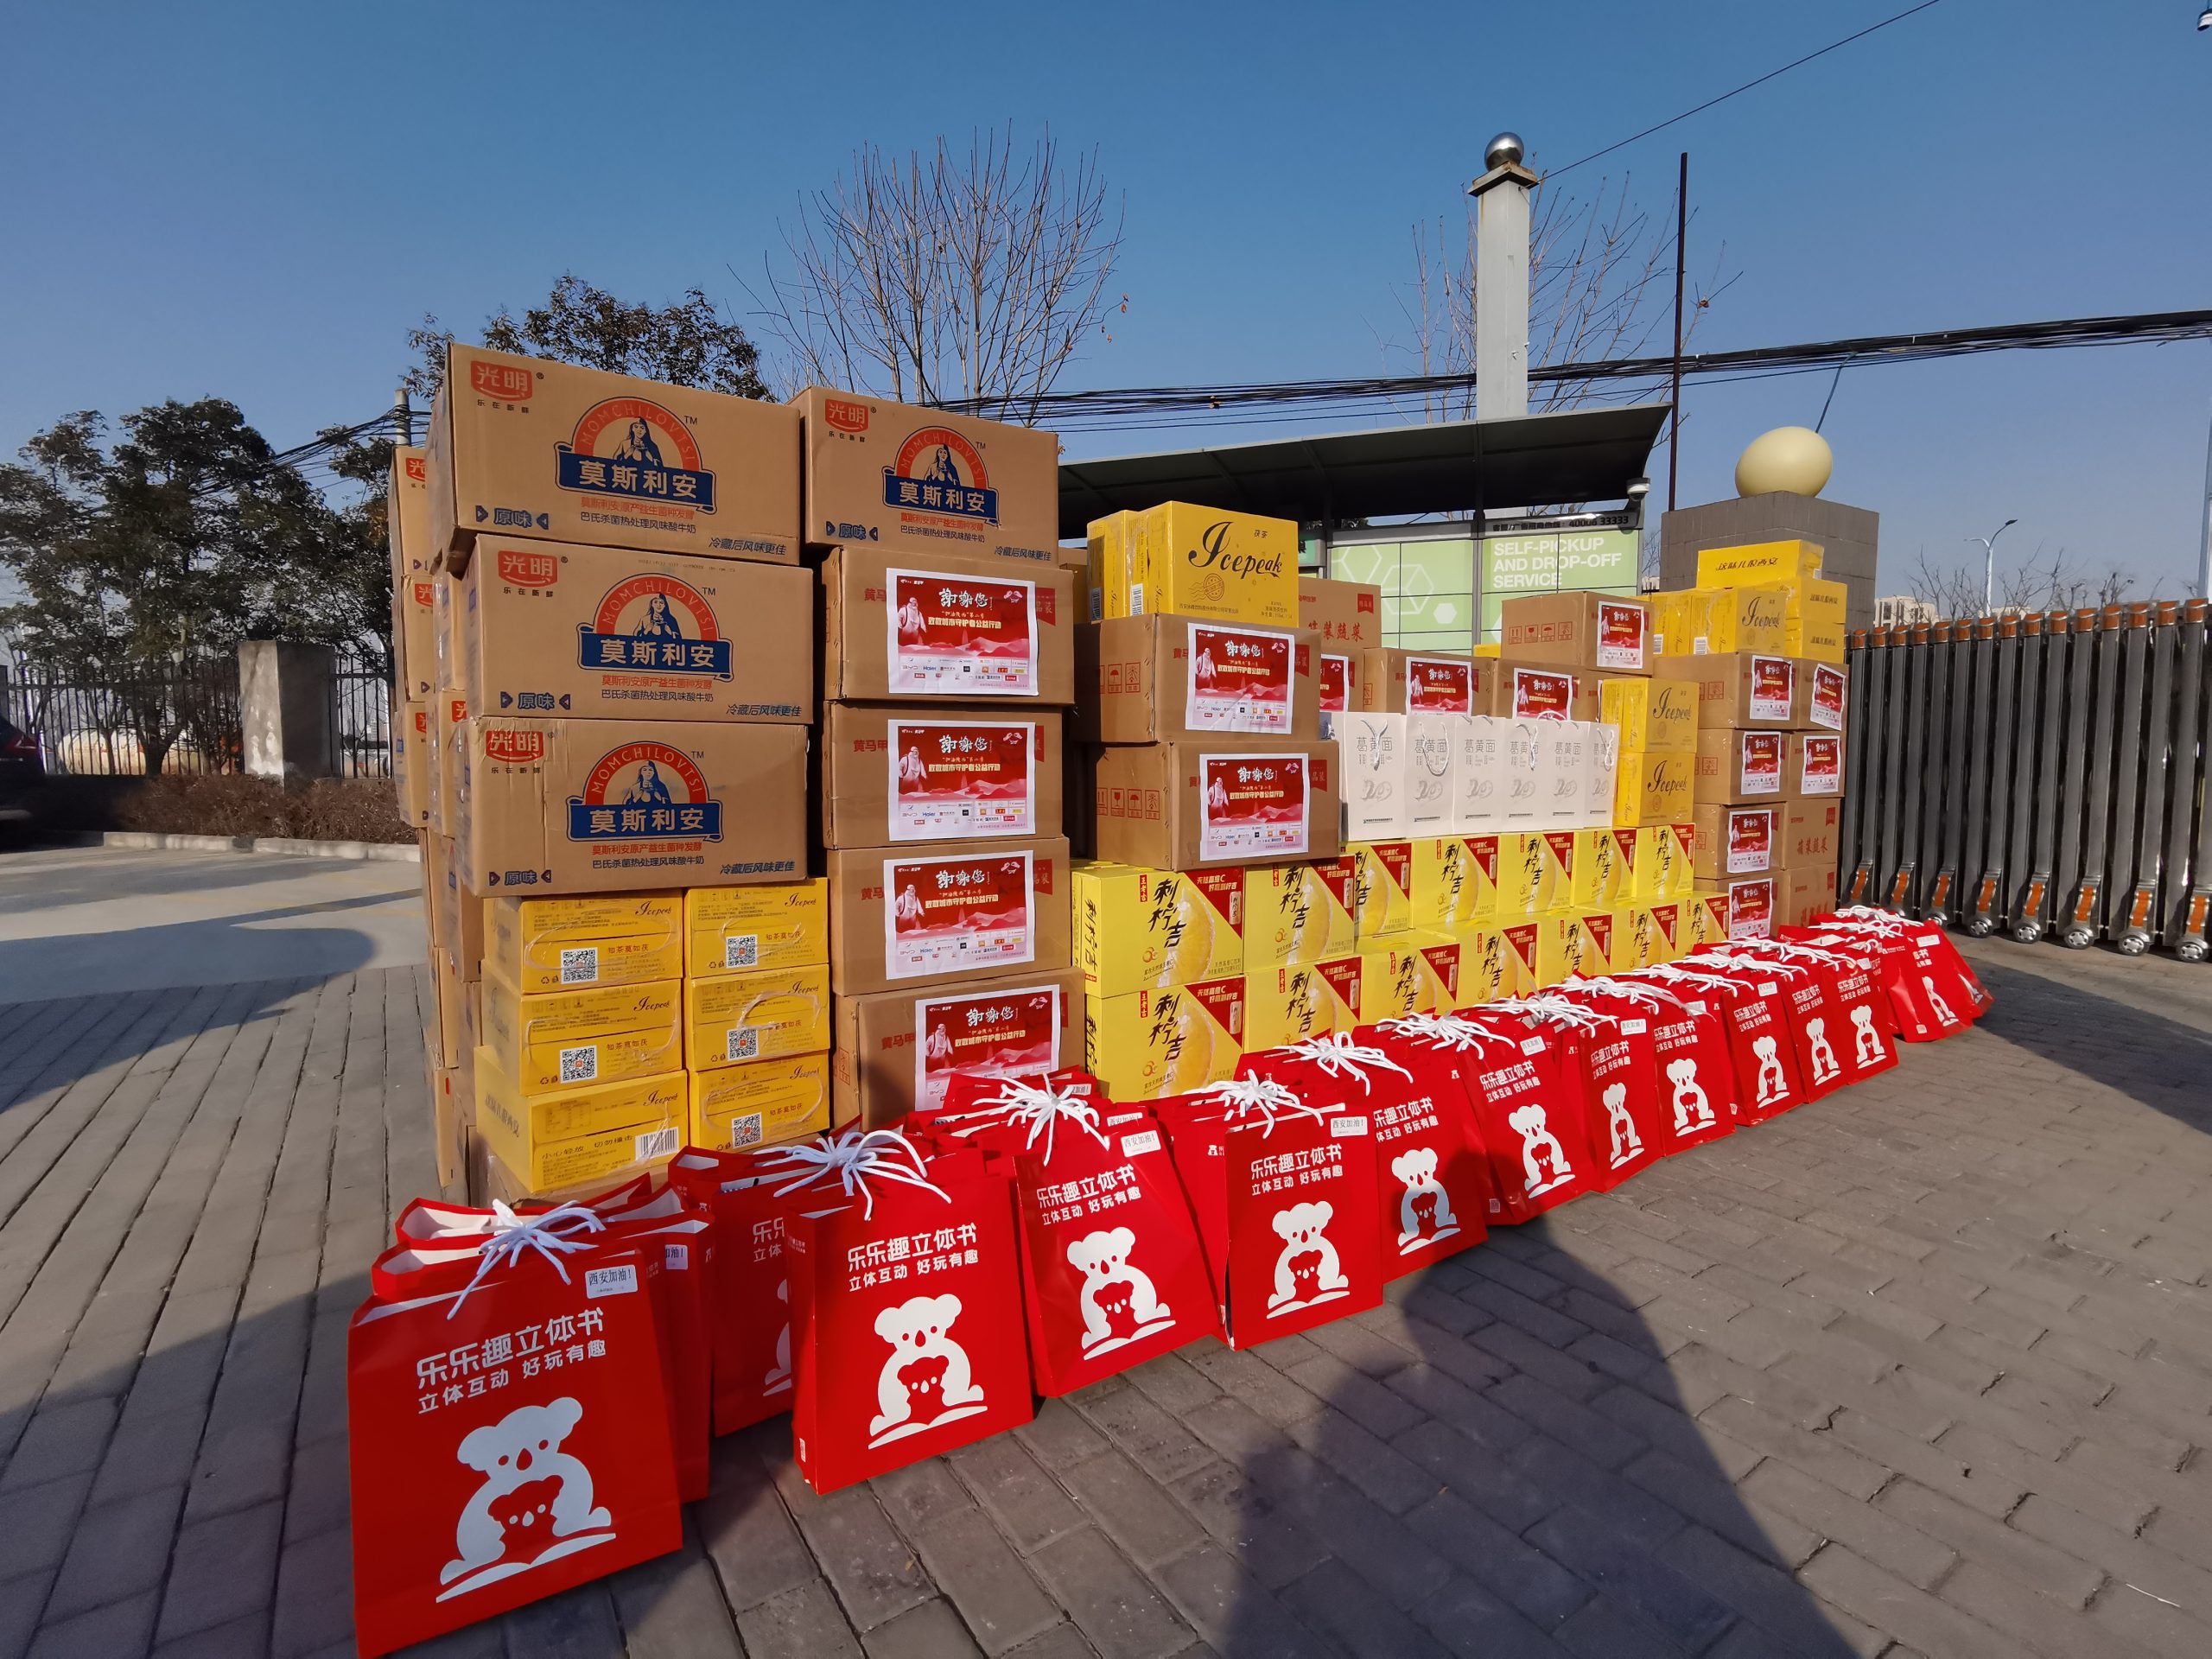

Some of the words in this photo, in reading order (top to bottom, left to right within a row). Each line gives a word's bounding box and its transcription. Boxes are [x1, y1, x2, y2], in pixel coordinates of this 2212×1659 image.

[475, 365, 528, 394] 光明
[830, 402, 865, 426] 光明
[581, 403, 696, 463] MOMCHILOVTSI
[579, 460, 698, 499] 莫斯利安
[899, 481, 985, 513] 莫斯利安
[494, 508, 531, 528] 原味
[581, 512, 696, 534] 巴氏杀菌热处理风味酸牛奶
[839, 524, 866, 540] 原味
[900, 525, 985, 543] 巴氏杀菌热处理风味酸牛奶
[709, 537, 786, 556] 冷藏后风味更佳
[995, 545, 1052, 561] 冷藏后风味更佳
[1188, 521, 1282, 580] Icepeak
[1494, 537, 1604, 556] SELF-PICKUP
[502, 556, 554, 580] 光明
[1494, 559, 1528, 572] AND
[1532, 553, 1622, 569] DROP-OFF
[1493, 573, 1562, 588] SERVICE
[602, 582, 714, 632] MOMCHILOVTSI
[600, 639, 715, 668] 莫斯利安
[518, 692, 555, 709] 原味
[601, 690, 713, 702] 巴氏杀菌热处理风味酸牛奶
[726, 703, 802, 717] 冷藏后风味更佳
[488, 729, 541, 757] 光明
[854, 739, 887, 753] 黄马甲
[1465, 739, 1496, 753] 葛黄面
[1554, 741, 1581, 755] 葛黄面
[591, 747, 702, 794] MOMCHILOVTSI
[589, 807, 703, 834] 莫斯利安
[592, 842, 702, 855] 莫斯利安原产益生菌种发酵
[592, 855, 704, 868] 巴氏杀菌热处理风味酸牛奶
[1524, 838, 1542, 885] 刺柠吉
[505, 870, 537, 885] 原味
[720, 861, 795, 875] 冷藏后风味更佳
[1441, 843, 1464, 894] 刺柠吉
[1281, 866, 1309, 929] 刺柠吉
[1148, 878, 1186, 948] 刺柠吉
[1482, 936, 1503, 987] 刺柠吉
[1394, 955, 1417, 1011] 刺柠吉
[1286, 971, 1315, 1033] 刺柠吉
[1149, 994, 1186, 1062] 刺柠吉
[1591, 1040, 1629, 1067] 乐乐趣立体书
[1479, 1060, 1535, 1090] 乐乐趣立体书
[1593, 1069, 1607, 1079] 立体互动
[1608, 1056, 1630, 1071] 好玩有趣
[1486, 1089, 1512, 1103] 立体互动
[1514, 1077, 1541, 1093] 好玩有趣
[1404, 1116, 1439, 1134] 好玩有趣
[1251, 1144, 1342, 1179] 乐乐趣立体书
[1037, 1164, 1136, 1209] 乐乐趣立体书
[1252, 1179, 1294, 1195] 立体互动
[1300, 1165, 1343, 1185] 好玩有趣
[1042, 1205, 1083, 1225] 立体互动
[1088, 1186, 1141, 1213] 好玩有趣
[849, 1222, 976, 1272] 乐乐趣立体书
[849, 1264, 907, 1292] 立体互动
[917, 1249, 978, 1275] 好玩有趣
[416, 1307, 604, 1389] 乐乐趣立体书
[418, 1369, 509, 1414] 立体互动
[523, 1339, 606, 1379] 好玩有趣
